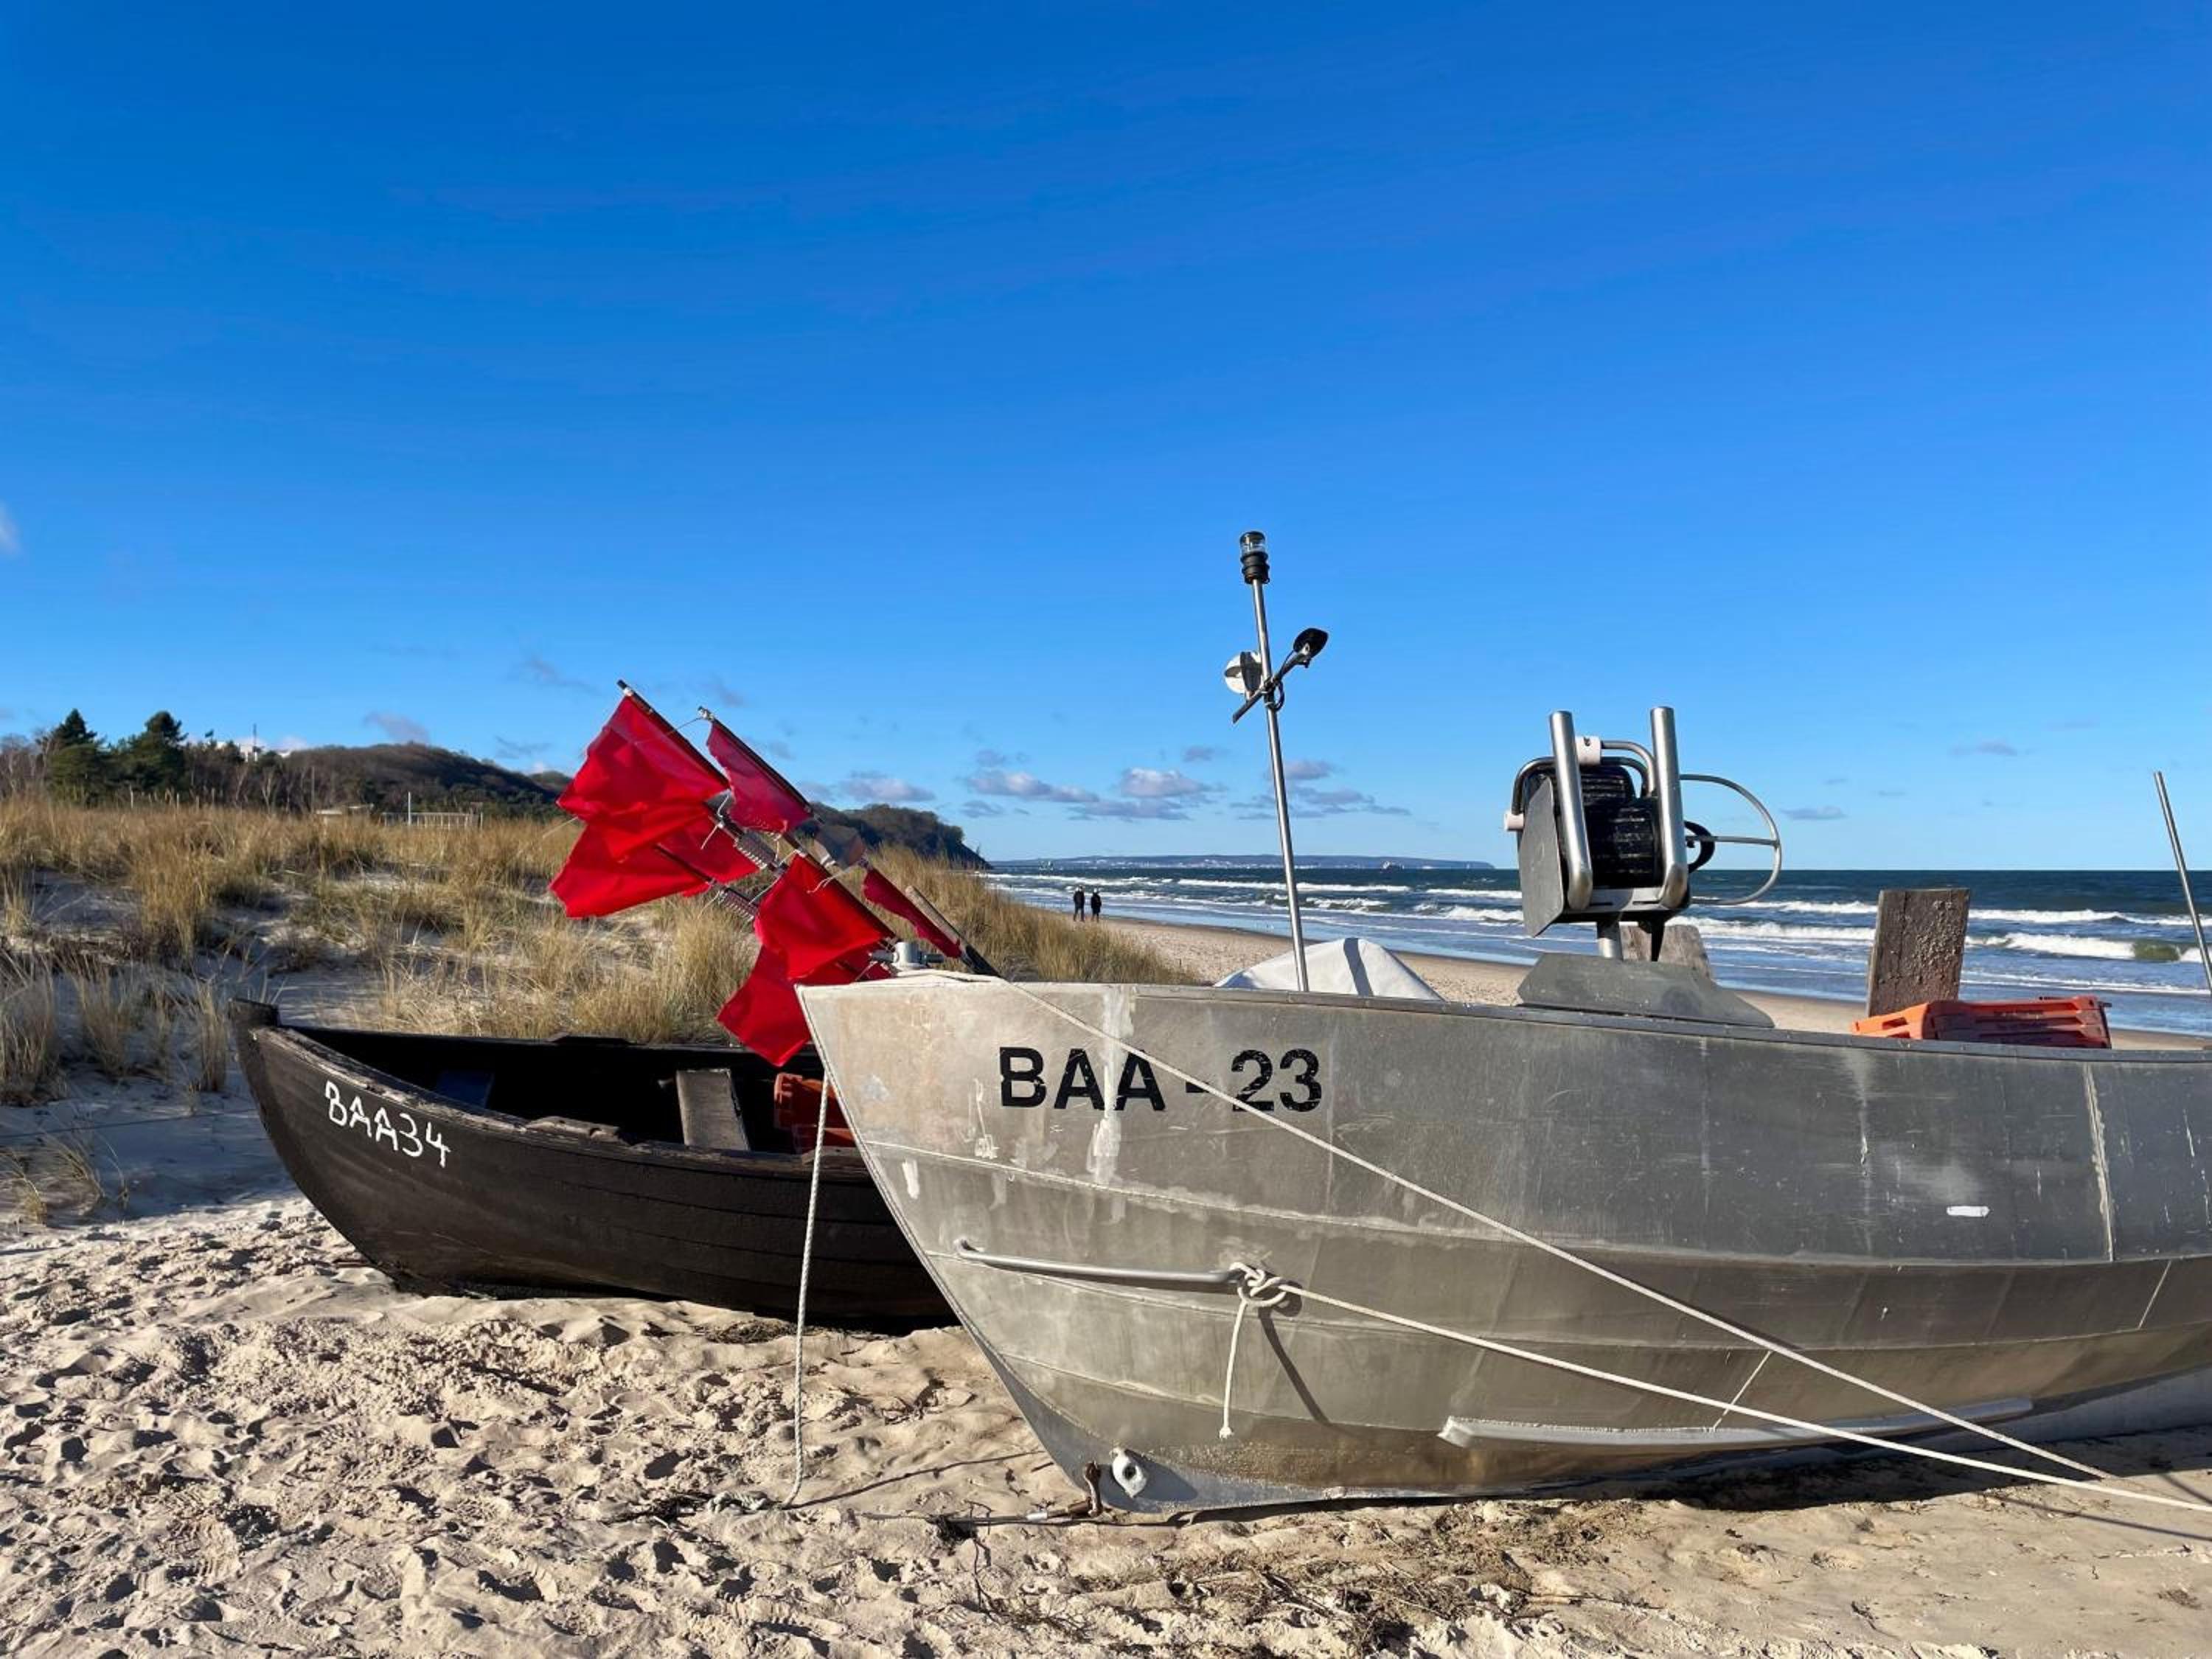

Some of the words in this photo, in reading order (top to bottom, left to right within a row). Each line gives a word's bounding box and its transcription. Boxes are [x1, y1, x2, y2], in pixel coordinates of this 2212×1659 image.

[1000, 1047, 1166, 1111] BAA
[1186, 1081, 1210, 1093] -
[1231, 1048, 1322, 1112] 23
[325, 1079, 451, 1168] BAA34
